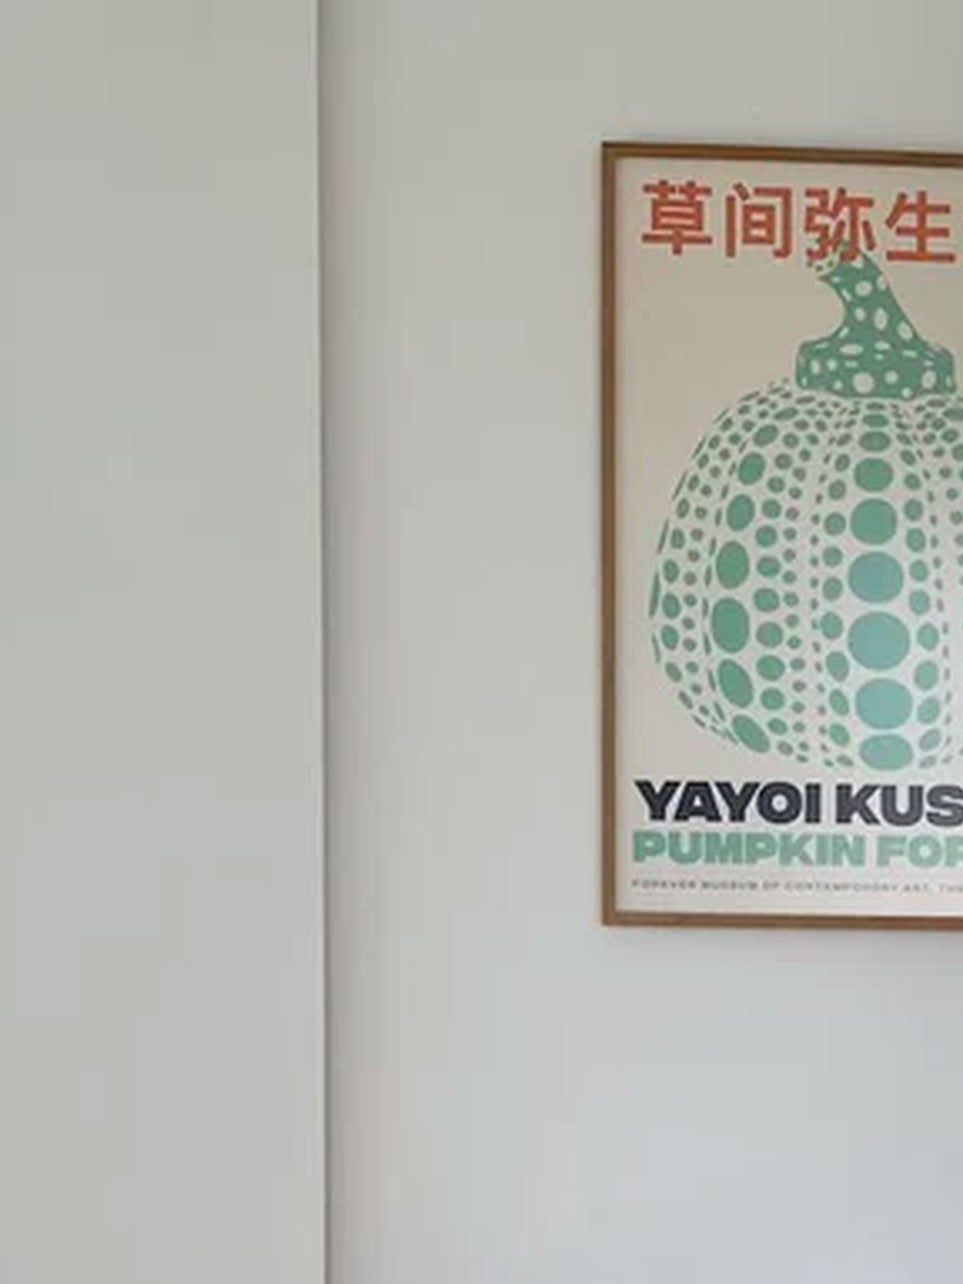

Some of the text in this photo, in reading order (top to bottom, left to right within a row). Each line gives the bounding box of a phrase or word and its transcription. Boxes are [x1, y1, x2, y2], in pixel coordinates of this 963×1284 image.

[634, 780, 820, 823] YAYOI
[633, 831, 866, 867] PUMPKIN
[631, 879, 697, 890] FOREVER
[701, 880, 758, 891] MUSEUM
[762, 880, 780, 891] OF
[784, 881, 899, 892] CONTEMPORARY
